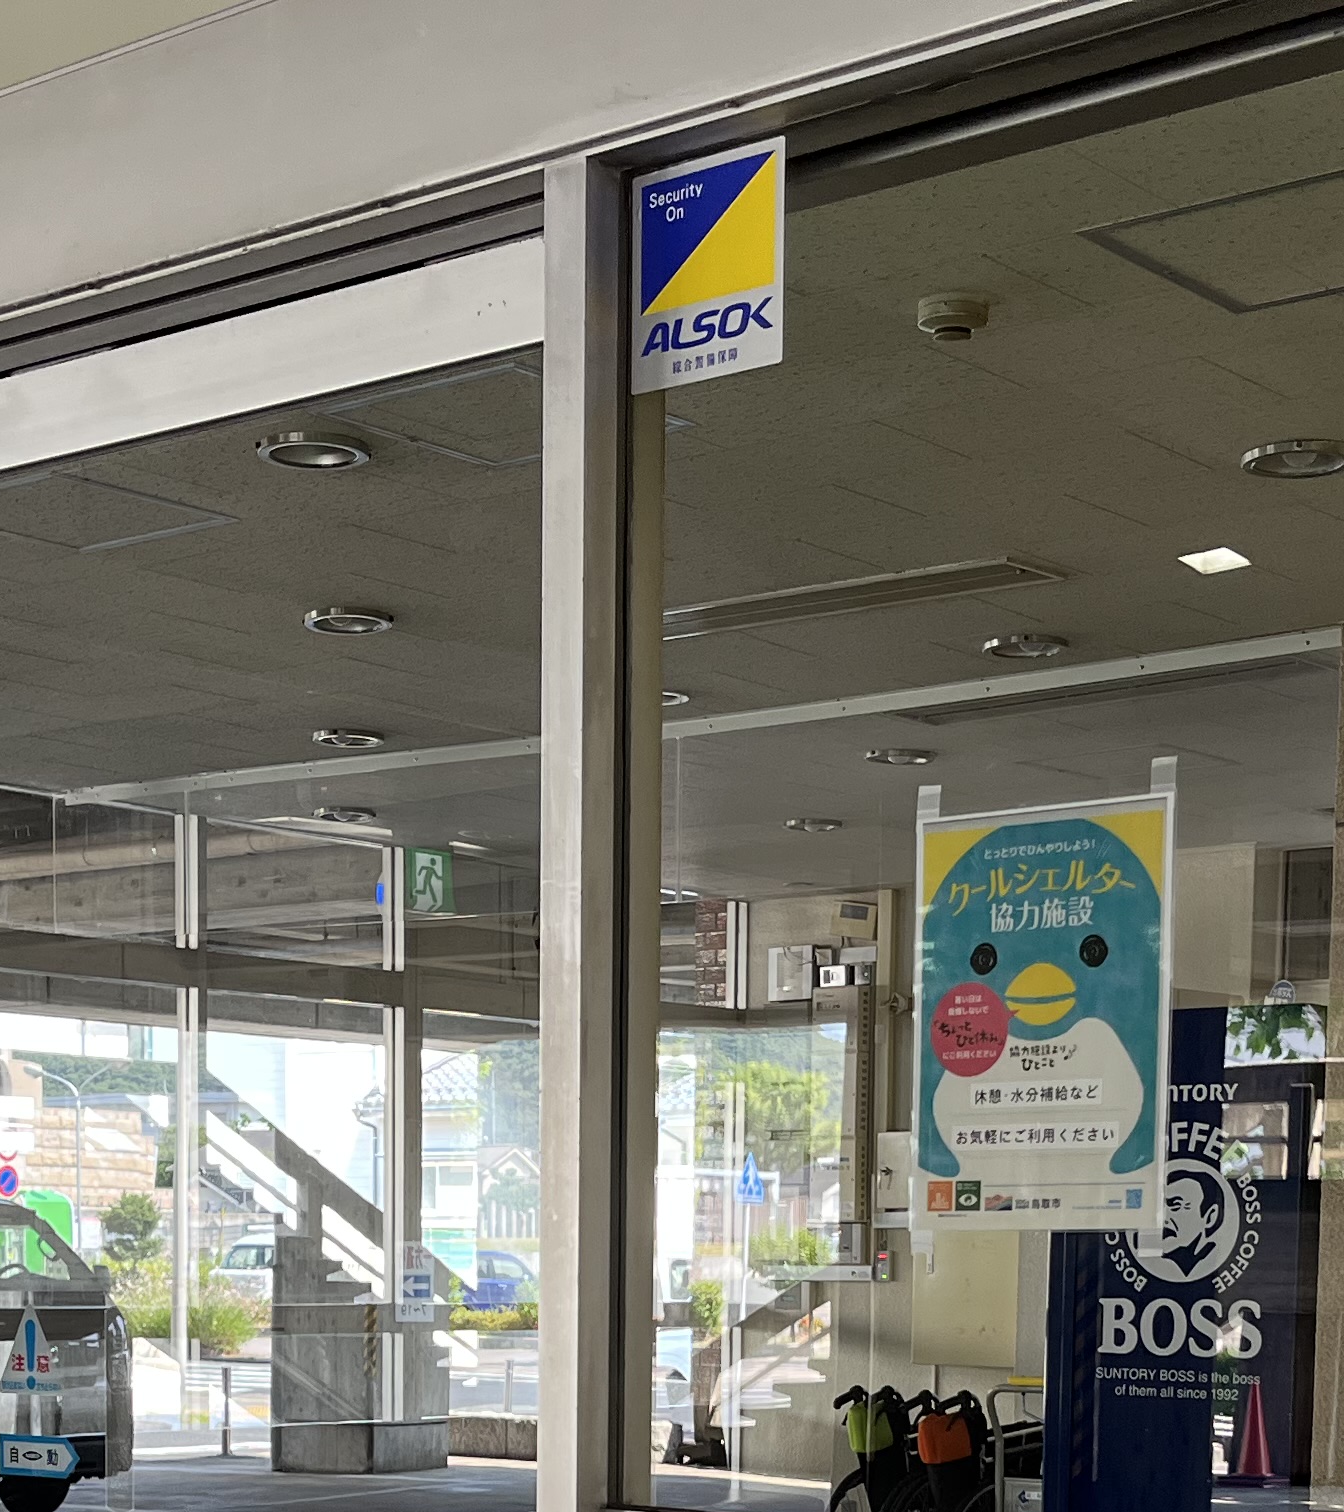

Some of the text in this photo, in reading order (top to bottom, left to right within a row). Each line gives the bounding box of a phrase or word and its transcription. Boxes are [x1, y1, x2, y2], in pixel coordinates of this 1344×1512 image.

[649, 182, 703, 209] Security
[665, 205, 684, 223] On
[640, 296, 774, 358] ALSOK
[948, 859, 1136, 917] クールシェルター
[989, 895, 1094, 933] 協力施設
[1021, 1057, 1054, 1071] ひとこと
[974, 1084, 1099, 1105] 休憩・水分補給など
[1168, 1083, 1239, 1102] NTORY
[955, 1127, 1115, 1145] お気軽にご利用ください
[1212, 1172, 1262, 1294] BOSS COFFEE
[1110, 1248, 1148, 1293] BOSS
[1097, 1297, 1262, 1359] BOSS
[1095, 1366, 1261, 1386] SUNTORY BOSS is the boss
[1114, 1384, 1239, 1401] of them all since 1992
